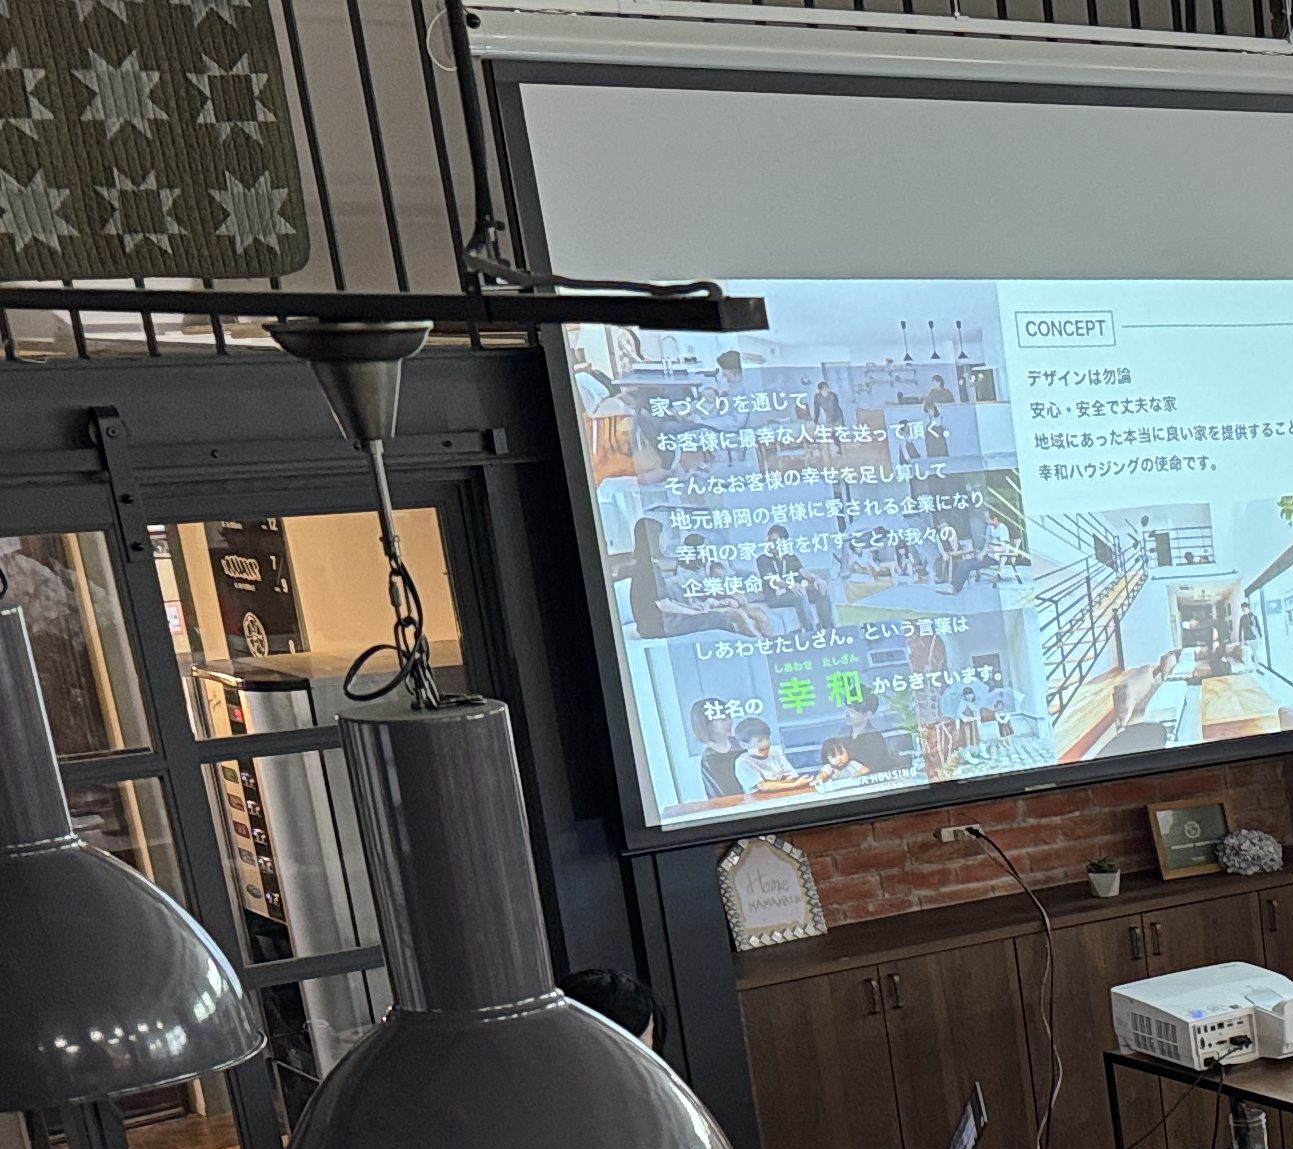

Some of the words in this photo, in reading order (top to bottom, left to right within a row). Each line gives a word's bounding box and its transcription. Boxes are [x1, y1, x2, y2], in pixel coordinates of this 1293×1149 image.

[1025, 319, 1107, 337] CONCEPT
[1027, 367, 1132, 387] デザインは勿論
[649, 392, 808, 418] 家づくりを通じて
[1030, 396, 1178, 419] 安心・安全で丈夫な家
[656, 421, 951, 453] お客様に最幸な人生を送って頂く。
[665, 462, 947, 496] そんなお客様の幸せを足し算して
[1038, 455, 1218, 481] 幸和ハウジングの使命です。
[670, 491, 985, 531] 地元静岡の皆様に愛される企業になり
[676, 526, 957, 564] 幸和の家で街を灯すことが我々の
[683, 571, 809, 599] 企業使命です。
[696, 616, 970, 661] しあわせたしざん。という言葉は
[774, 660, 813, 673] しあわせ
[704, 699, 764, 721] 社名の
[872, 665, 1003, 695] からきています。
